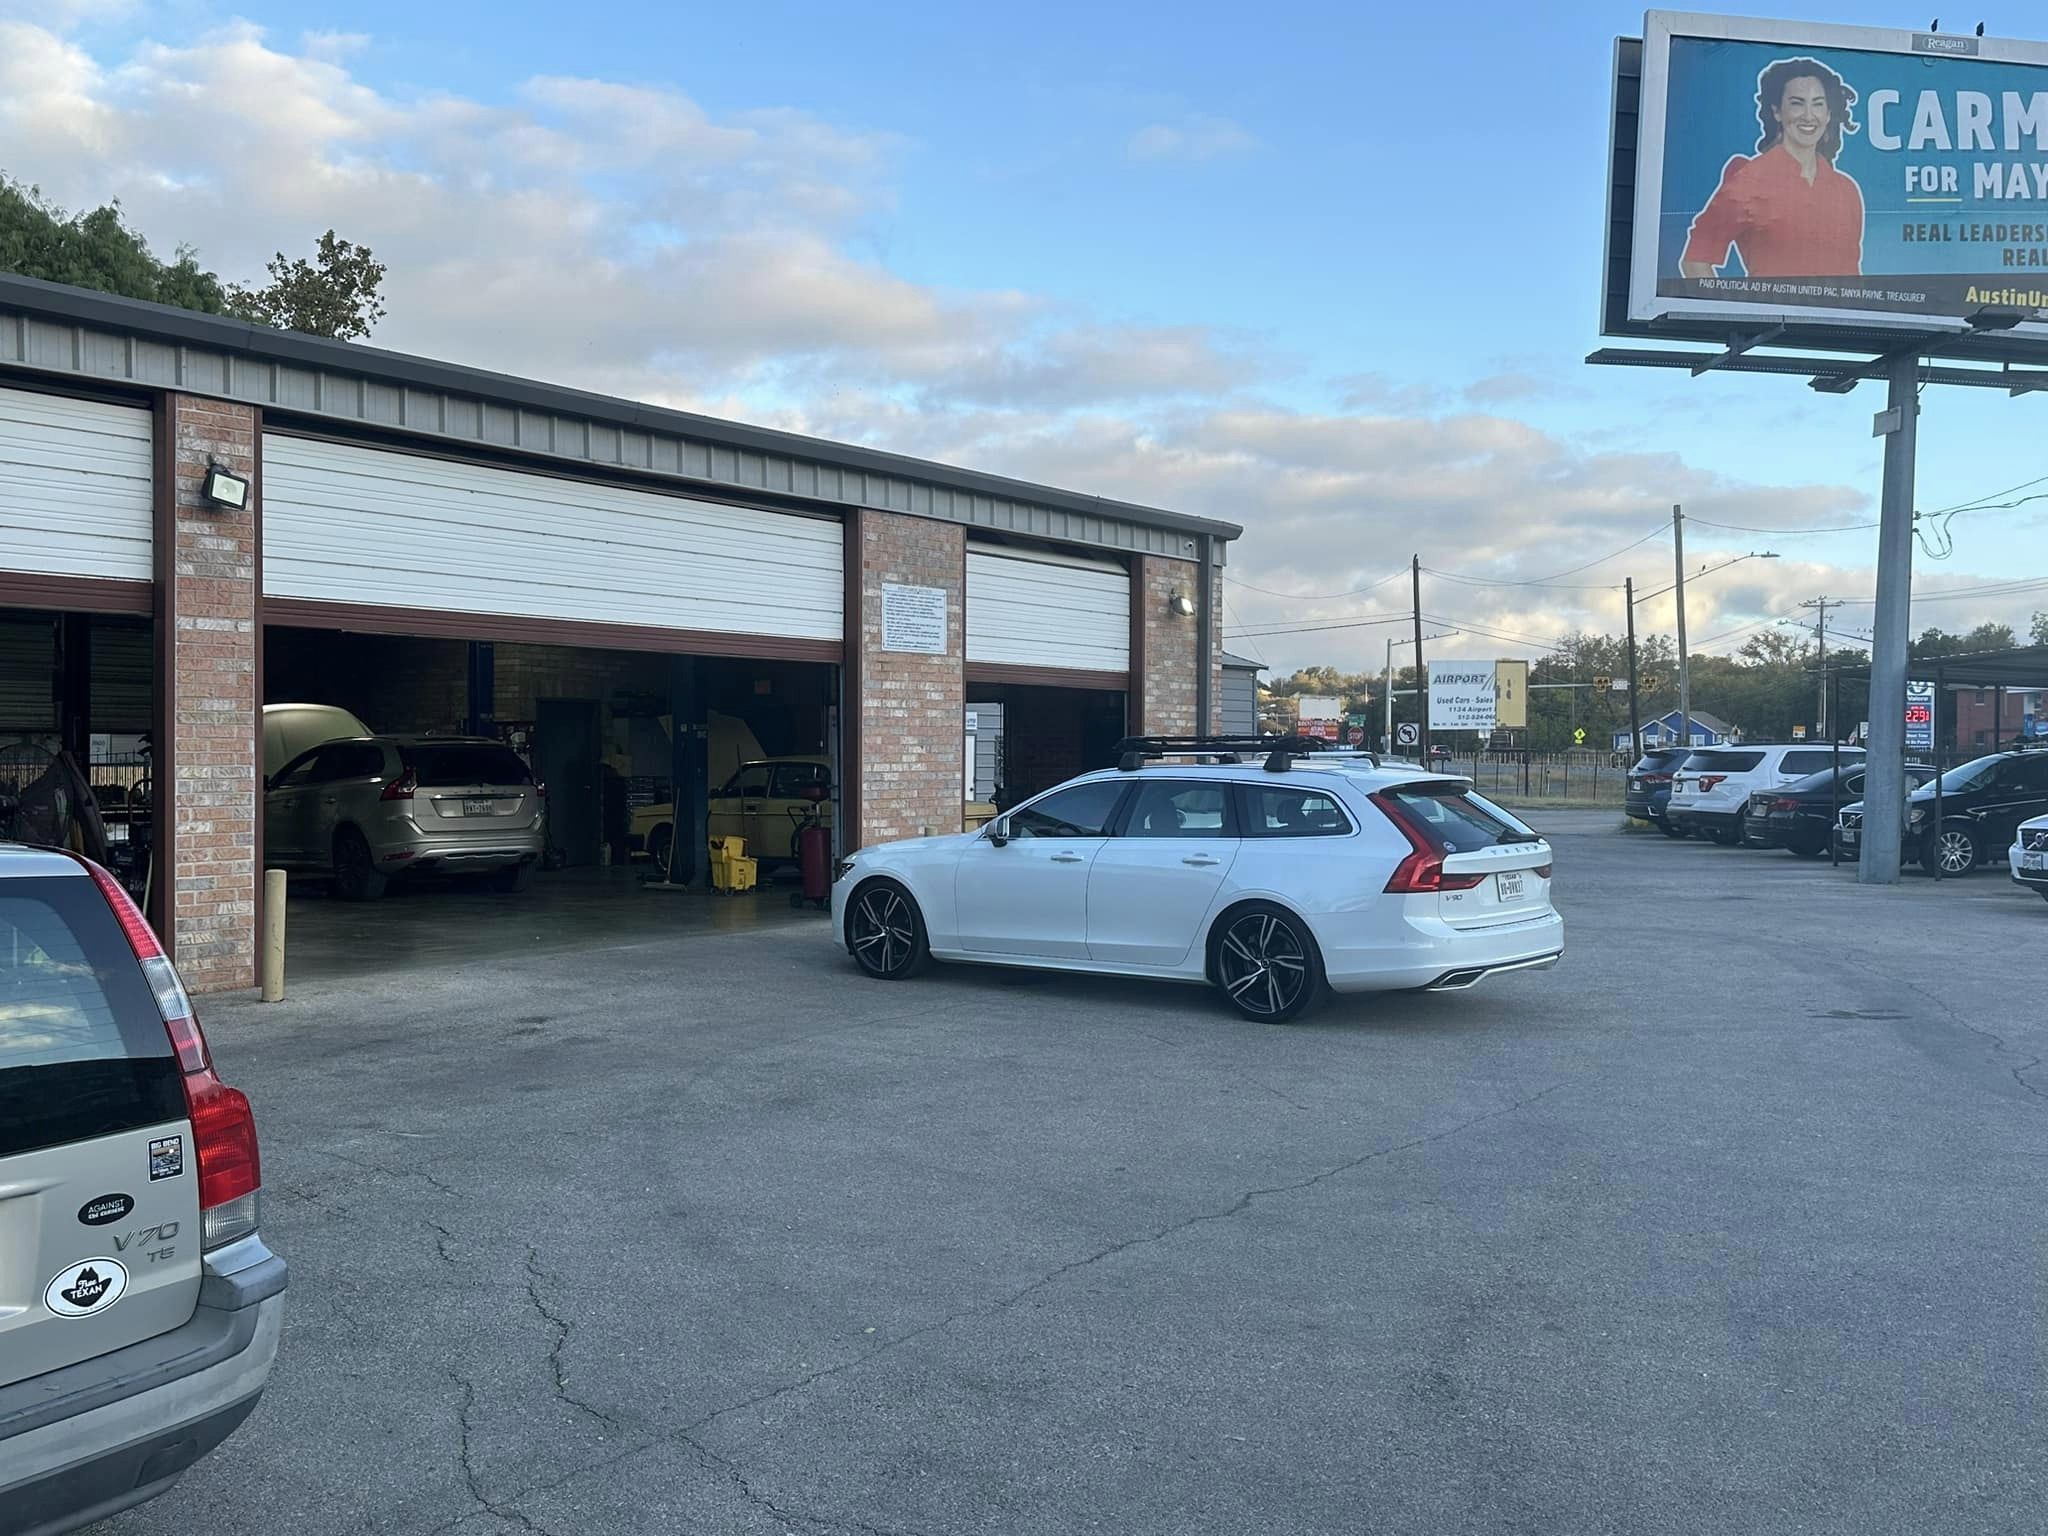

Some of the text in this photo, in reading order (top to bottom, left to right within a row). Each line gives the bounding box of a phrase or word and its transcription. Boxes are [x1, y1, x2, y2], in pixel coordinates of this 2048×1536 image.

[1928, 38, 1964, 49] Reagan
[1905, 165, 1958, 193] FOR
[1902, 223, 2048, 242] REAL LEADERS
[2003, 248, 2048, 267] REAL
[1699, 278, 1715, 288] PAID
[1716, 279, 1749, 291] POLITICAL
[1750, 281, 1760, 291] AD
[1762, 282, 1771, 292] BY
[1772, 283, 1797, 294] AUSTIN
[1798, 285, 1822, 296] UNITED
[1840, 288, 1860, 298] TANYA
[1886, 291, 1926, 303] TREASURER
[1433, 674, 1486, 685] AIRPORT
[1437, 697, 1454, 705] Used
[1455, 696, 1470, 704] Cars
[1476, 696, 1493, 704] Sales
[1348, 732, 1362, 740] STOP
[87, 1199, 125, 1214] AGAINST
[70, 1284, 103, 1299] TEXAN
